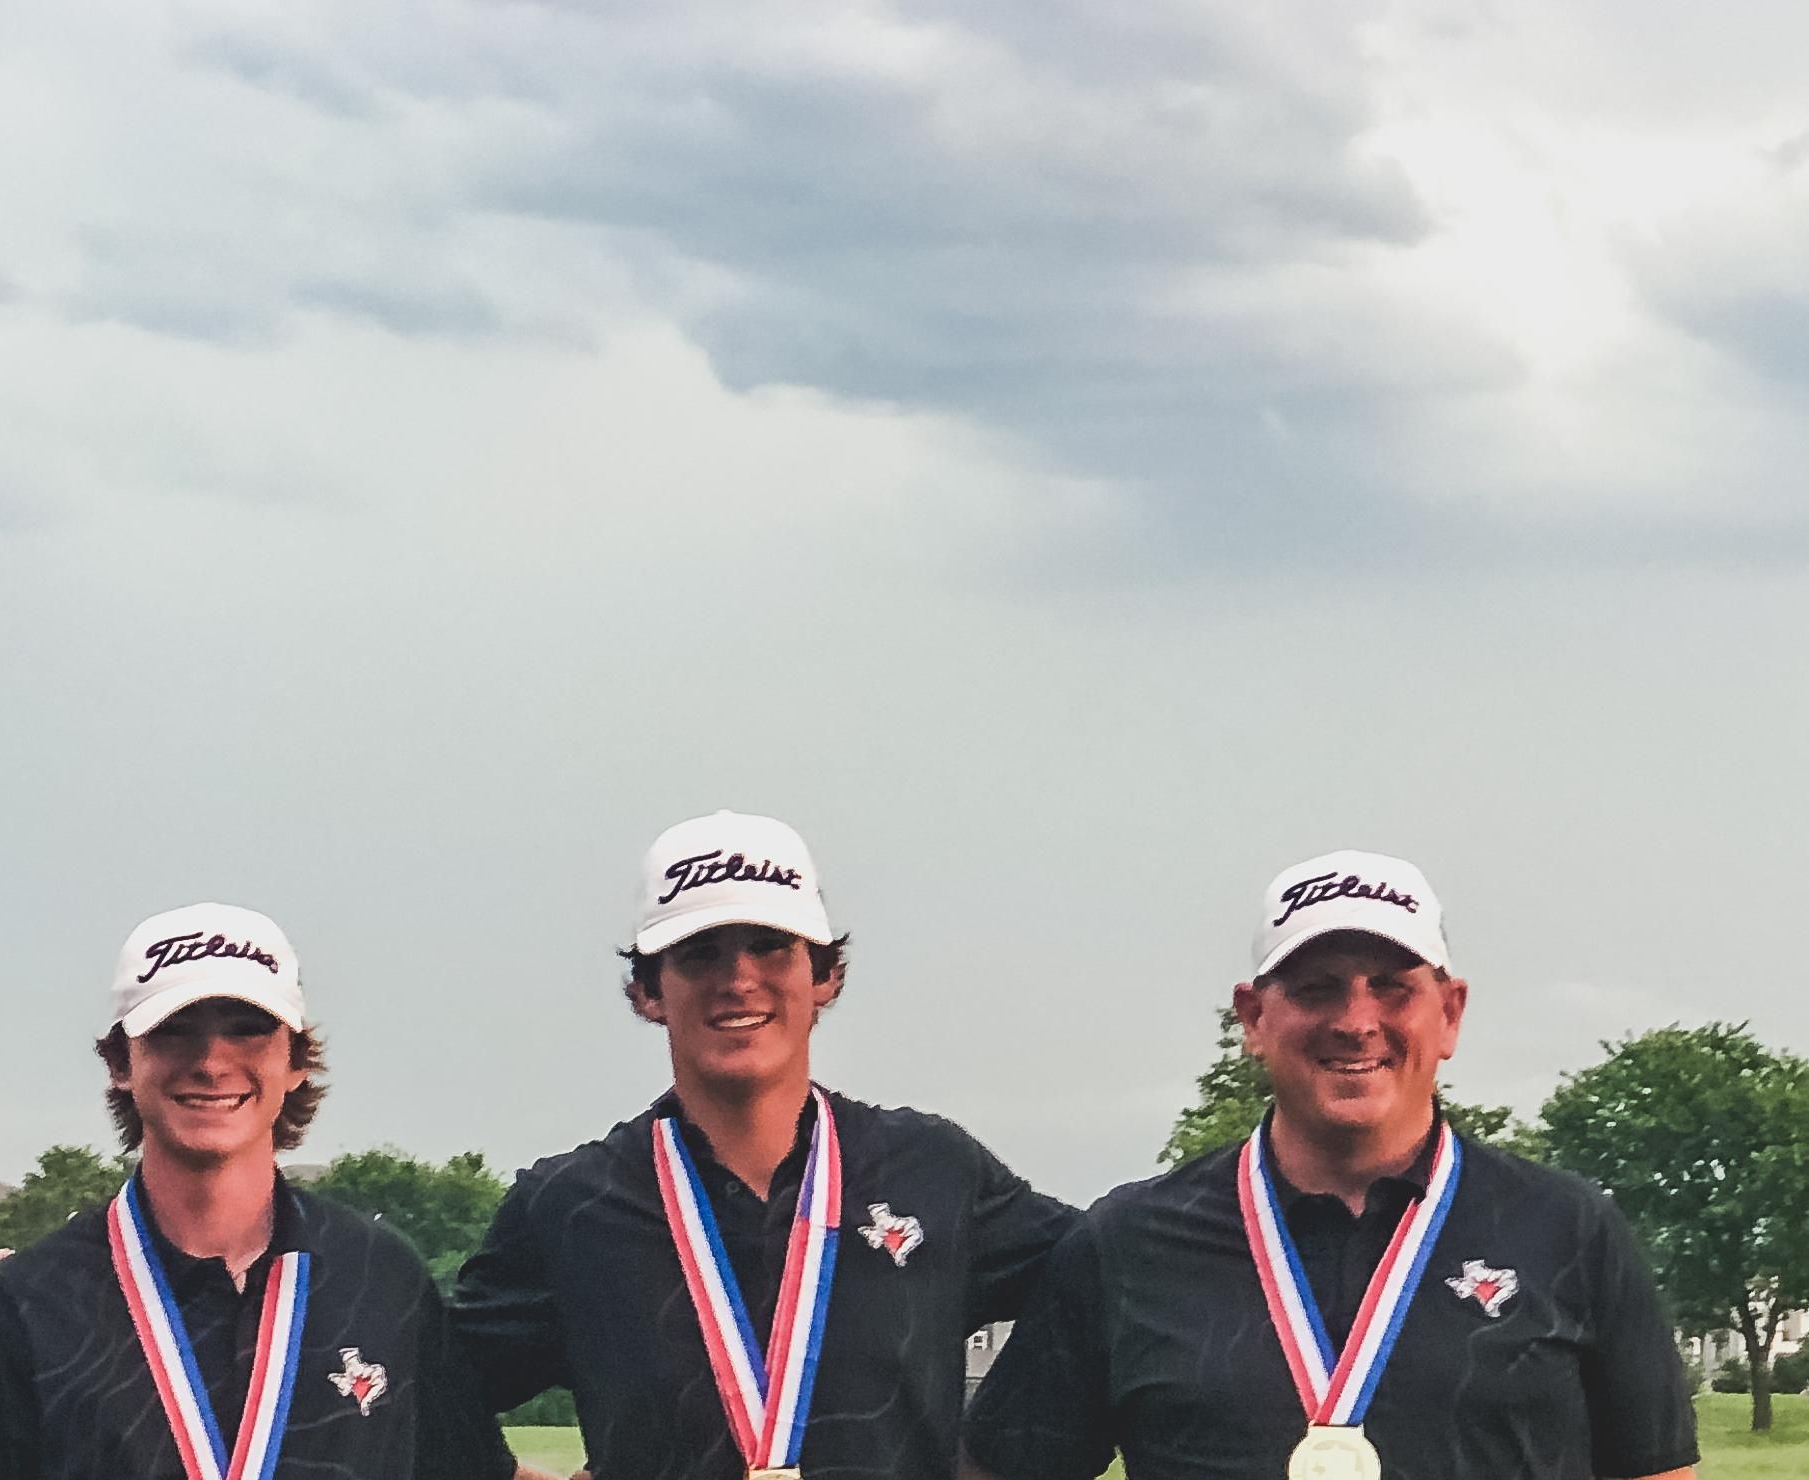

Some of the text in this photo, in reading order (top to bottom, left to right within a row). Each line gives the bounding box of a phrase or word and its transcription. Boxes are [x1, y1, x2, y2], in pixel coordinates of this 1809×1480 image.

[657, 849, 802, 904] Titleist
[1272, 872, 1419, 927] Titleist
[136, 932, 278, 983] Titleist
